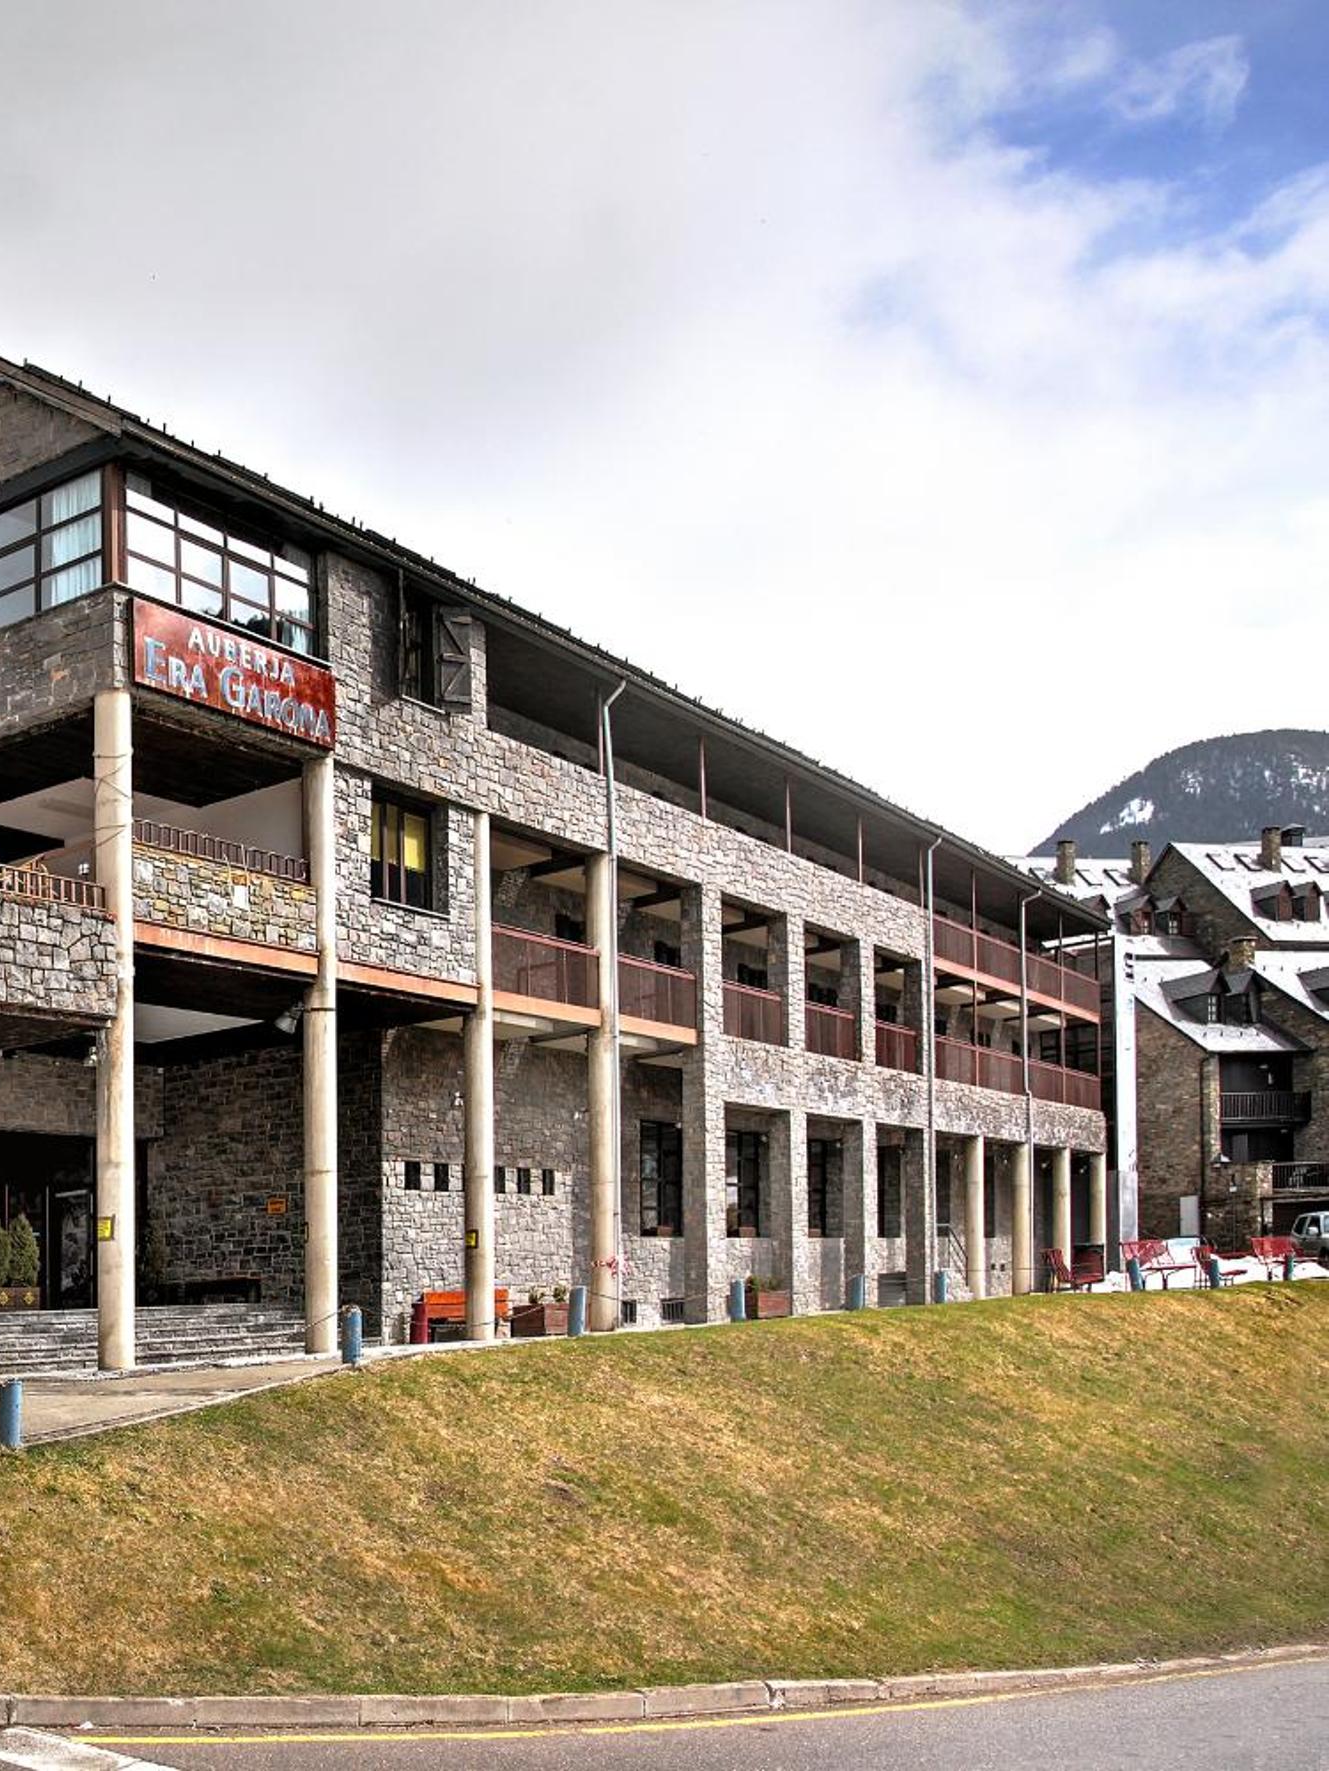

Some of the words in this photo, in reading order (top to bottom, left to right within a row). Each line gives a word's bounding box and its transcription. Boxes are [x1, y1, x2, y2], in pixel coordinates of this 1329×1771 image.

[143, 636, 208, 699] ERA
[219, 666, 332, 739] GARONA
[188, 627, 296, 687] AUBERJA
